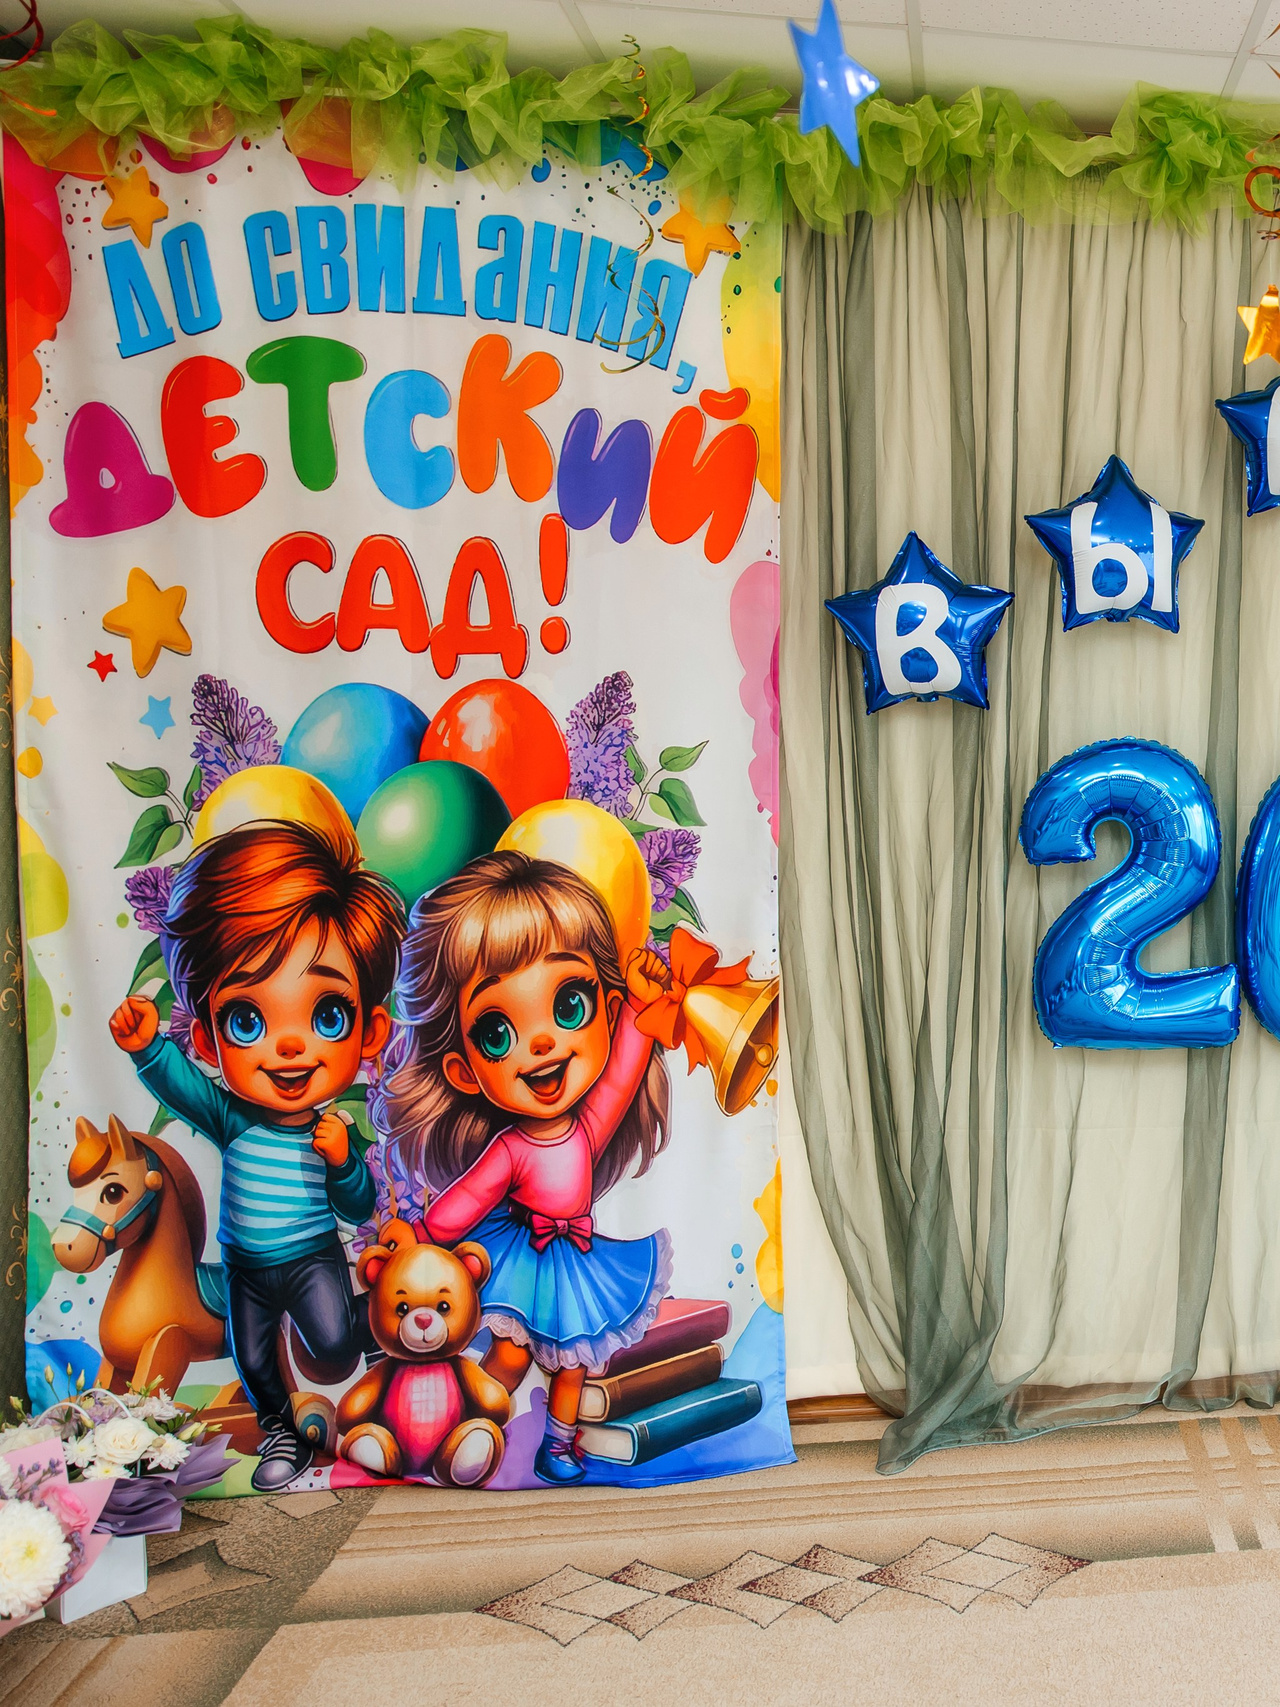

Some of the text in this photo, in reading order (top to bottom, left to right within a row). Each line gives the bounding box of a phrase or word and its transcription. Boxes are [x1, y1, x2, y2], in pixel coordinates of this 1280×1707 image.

[102, 222, 223, 358] ДО
[48, 334, 759, 564] ДЕТСКИЙ
[255, 514, 570, 680] САД!
